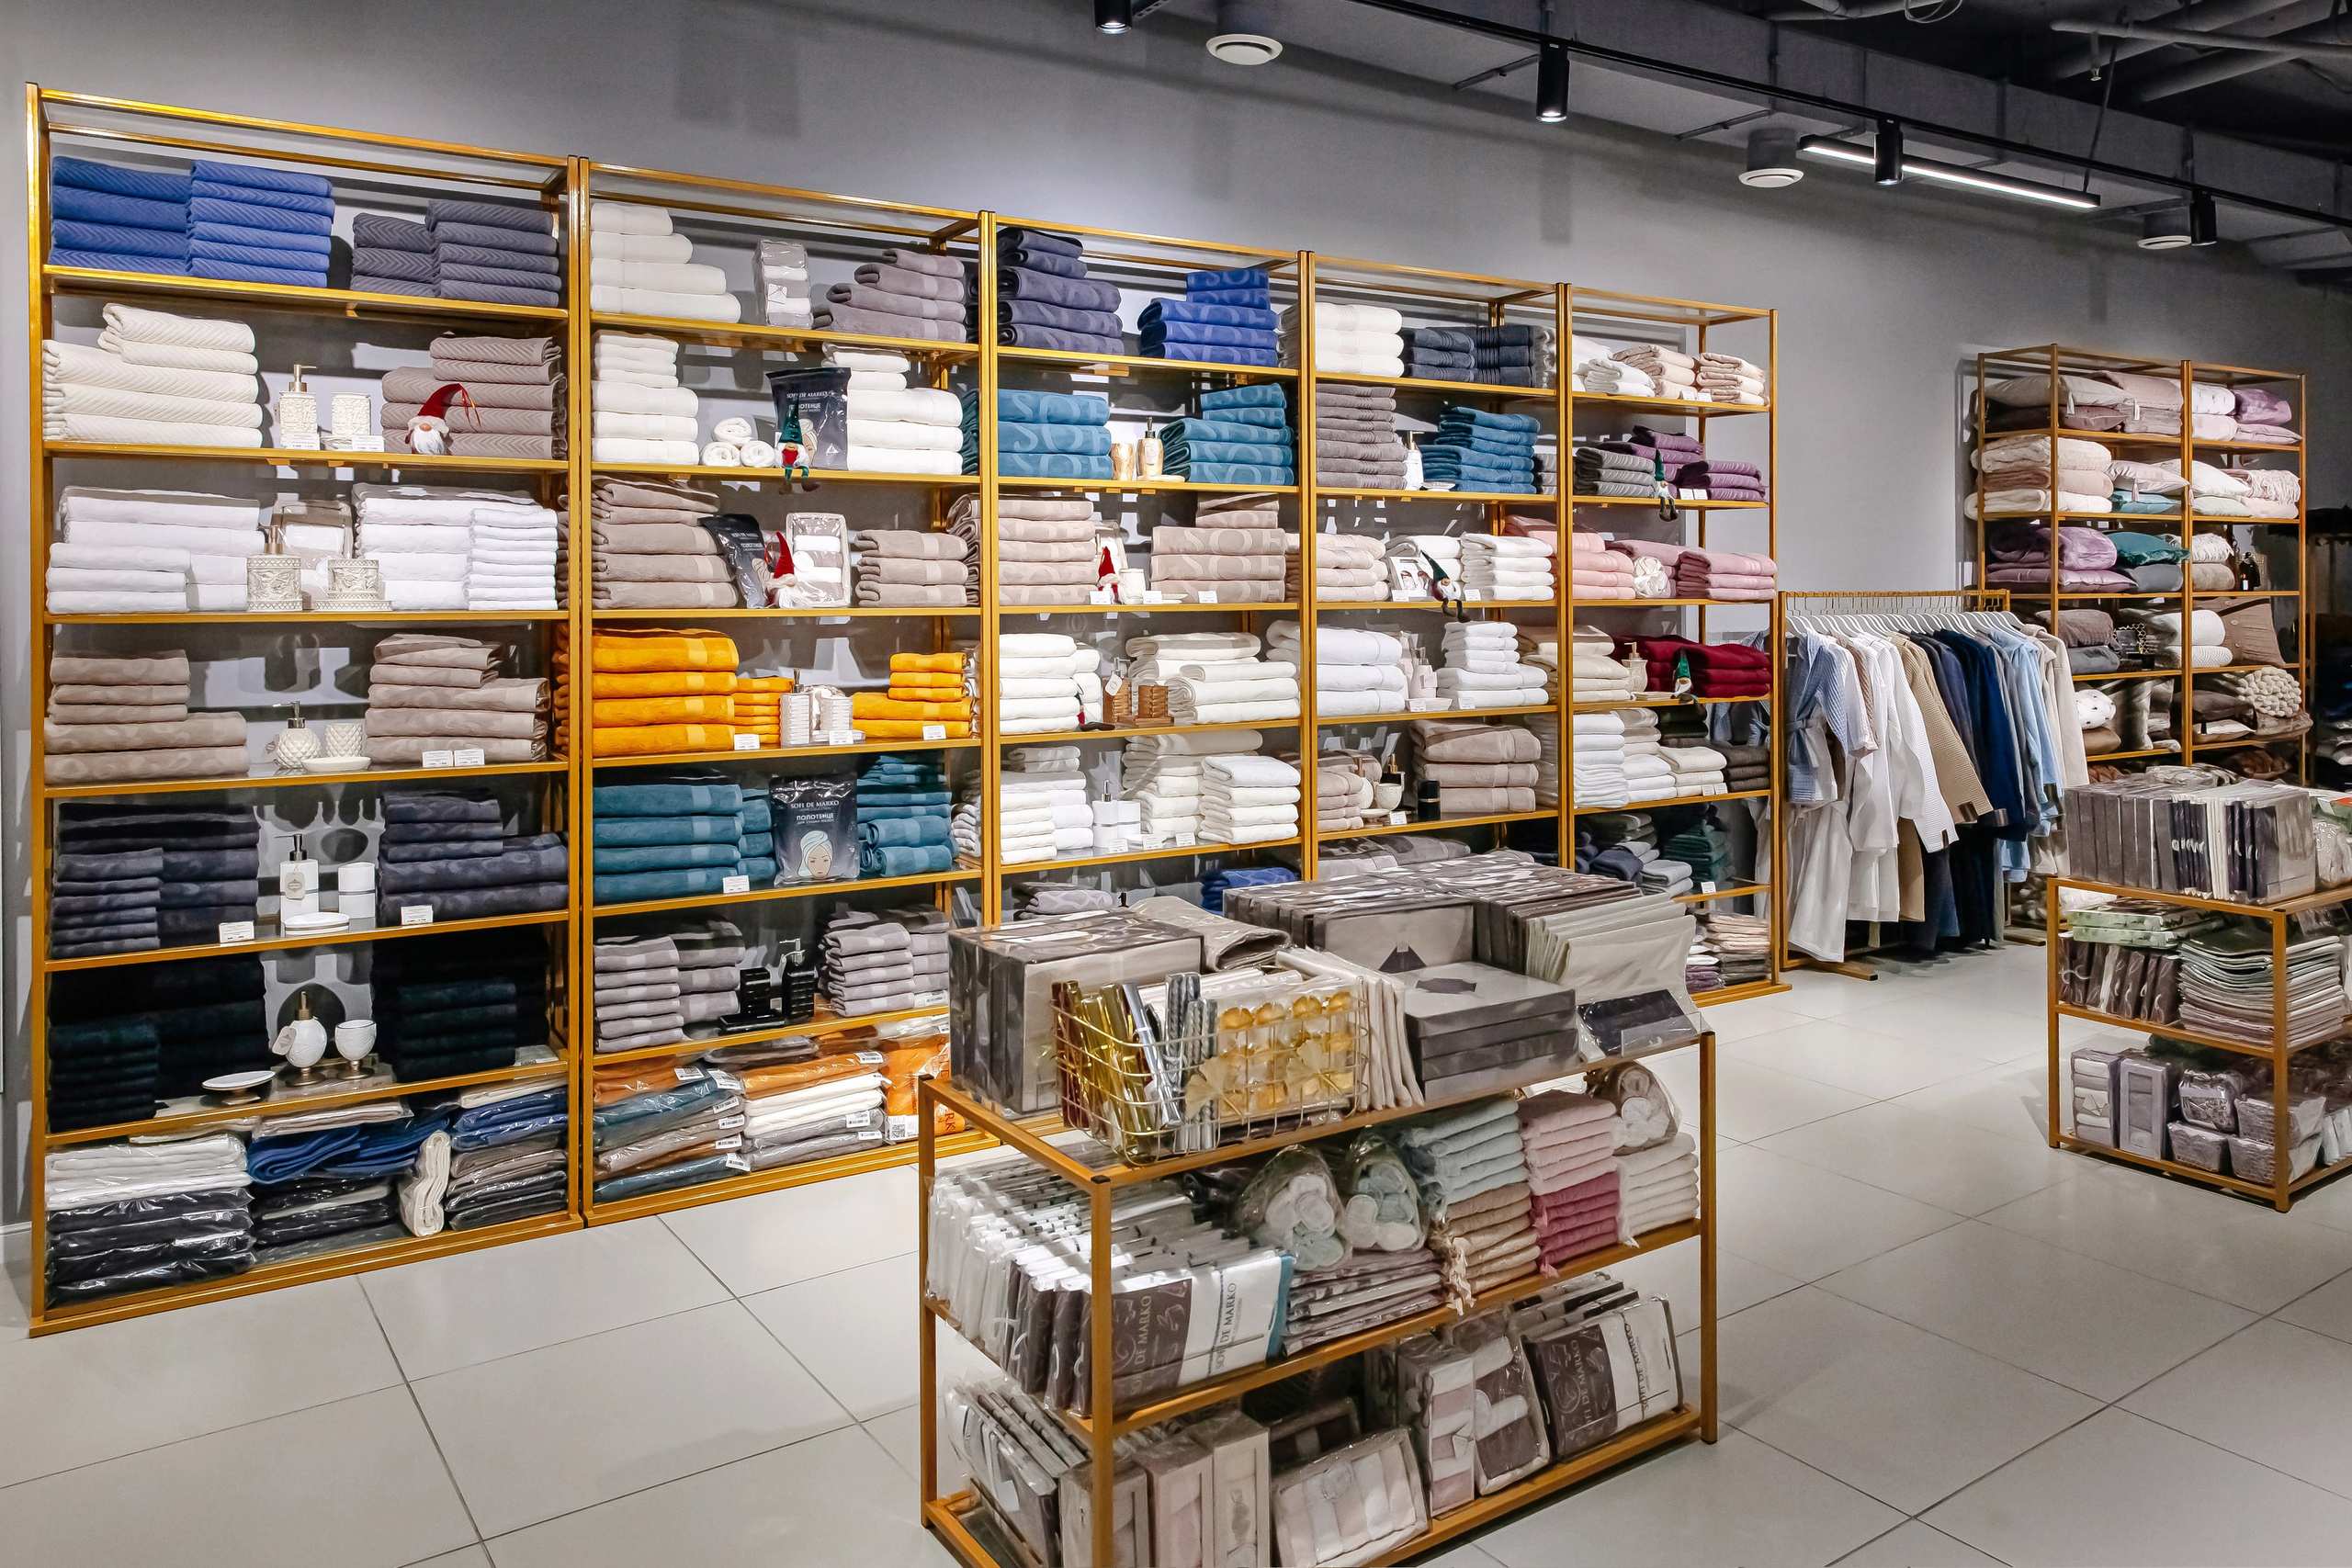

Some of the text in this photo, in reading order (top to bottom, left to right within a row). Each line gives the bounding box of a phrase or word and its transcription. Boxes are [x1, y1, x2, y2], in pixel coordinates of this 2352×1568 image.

[1223, 1282, 1237, 1325] MARKO
[1137, 1295, 1152, 1344] MARKO
[1219, 1329, 1231, 1344] DE
[1134, 1348, 1147, 1365] DE
[1570, 1339, 1587, 1385] MARKO
[1581, 1388, 1590, 1405] DE
